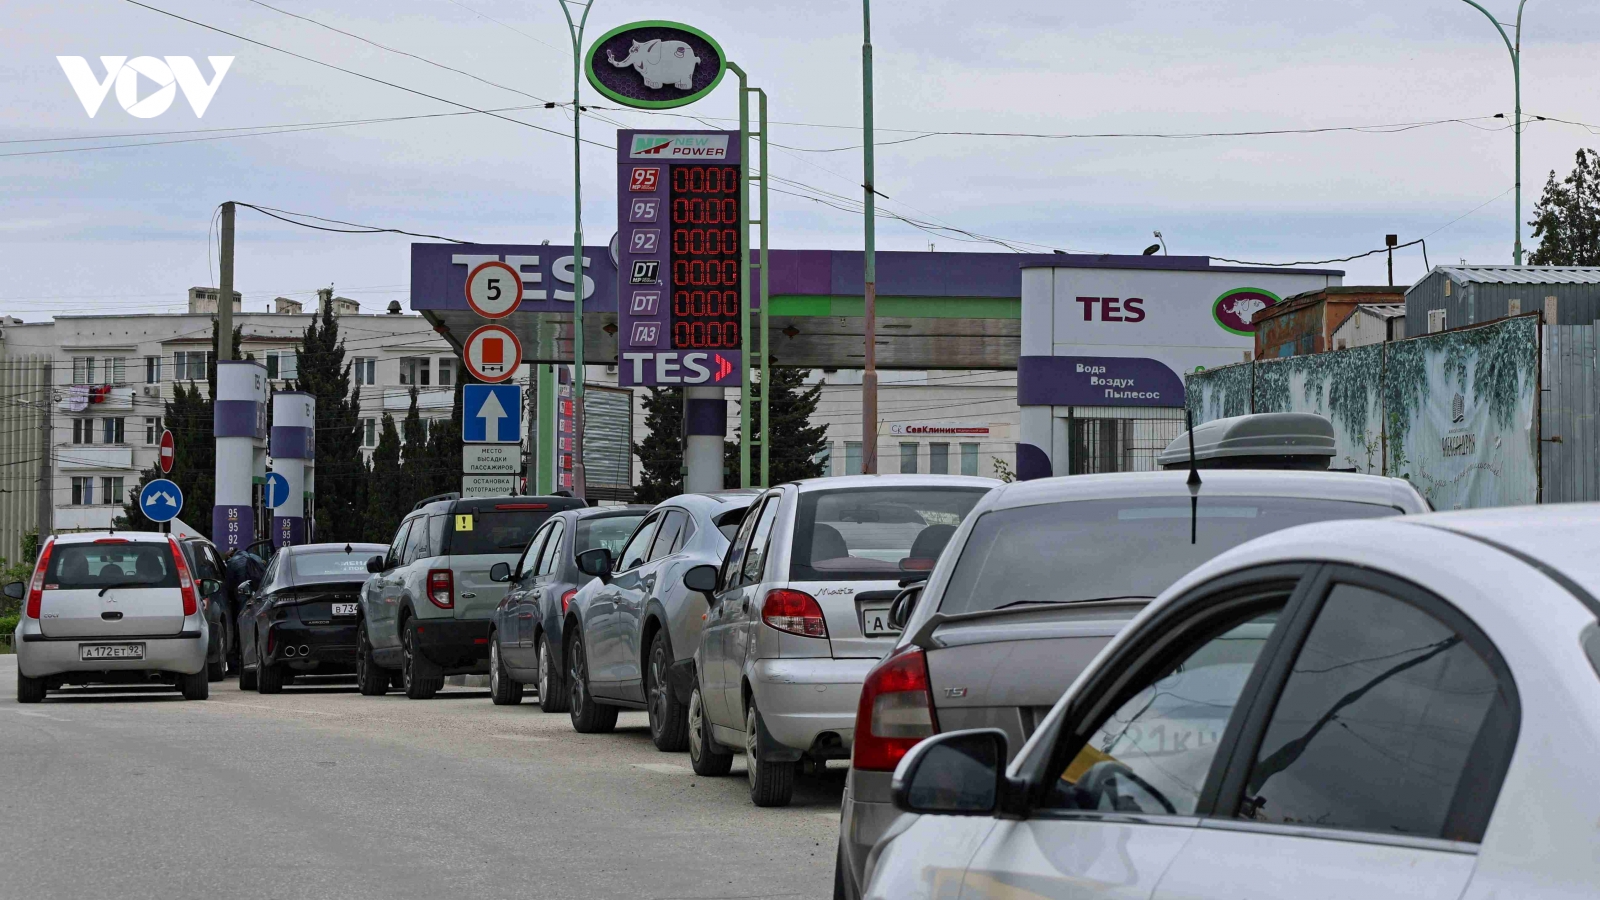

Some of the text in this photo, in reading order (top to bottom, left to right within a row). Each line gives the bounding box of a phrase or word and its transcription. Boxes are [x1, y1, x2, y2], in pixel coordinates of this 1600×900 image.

[674, 138, 709, 146] NEW
[672, 147, 724, 156] POWER
[634, 169, 656, 185] 95
[634, 203, 656, 218] 95
[634, 234, 656, 249] 92
[634, 262, 658, 277] DT
[487, 278, 502, 301] 5
[634, 295, 657, 311] DT
[1075, 296, 1146, 323] TES
[636, 326, 656, 342] ГАЗ
[623, 352, 711, 384] TES
[1076, 363, 1106, 375] Вода
[1090, 376, 1135, 387] Воздух
[1105, 388, 1160, 399] Пылесос
[905, 425, 956, 434] СевКлиник
[228, 508, 238, 518] 95
[228, 522, 239, 532] 95
[282, 518, 291, 527] 95
[228, 534, 238, 545] 92
[282, 530, 291, 539] 95
[814, 587, 854, 597] Matiz
[128, 645, 139, 654] 92
